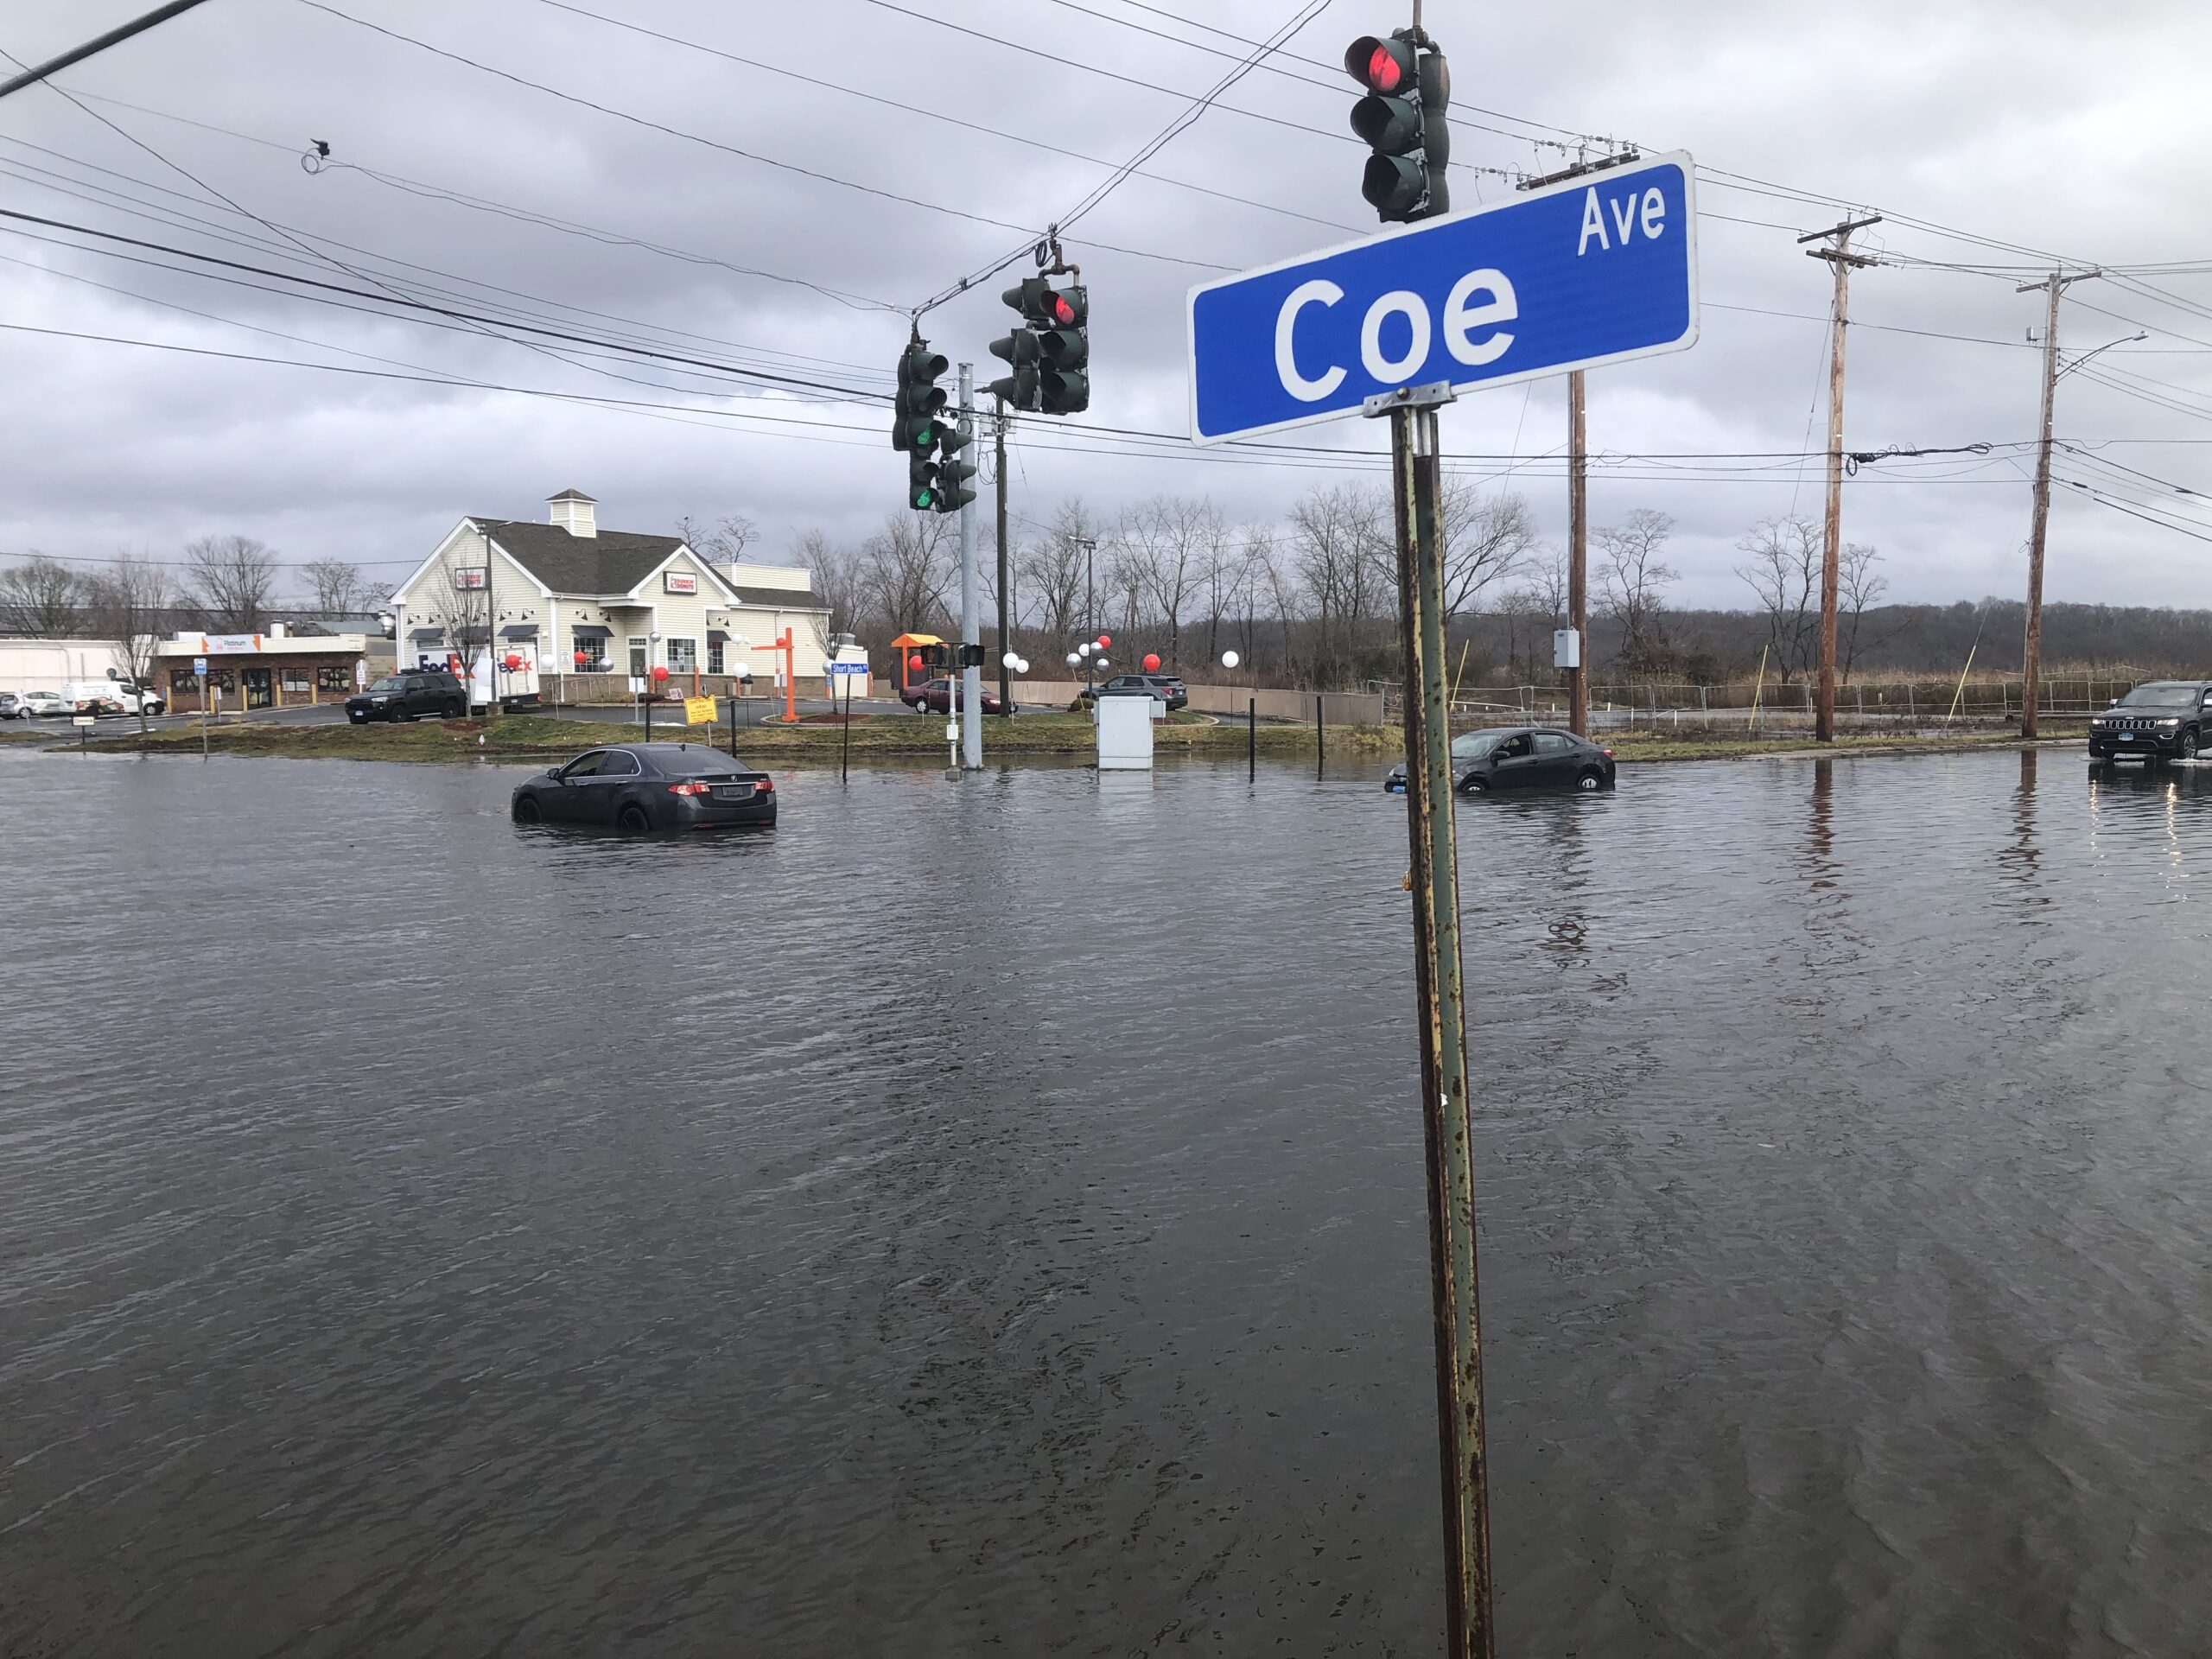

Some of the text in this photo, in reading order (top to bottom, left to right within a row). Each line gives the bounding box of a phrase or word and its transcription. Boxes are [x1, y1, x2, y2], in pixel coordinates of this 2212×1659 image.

[1578, 187, 1666, 257] Ave
[1274, 268, 1518, 403] Coe
[418, 653, 476, 679] FedEx
[497, 656, 533, 674] eEx
[833, 664, 847, 673] Short
[848, 664, 863, 673] Beach
